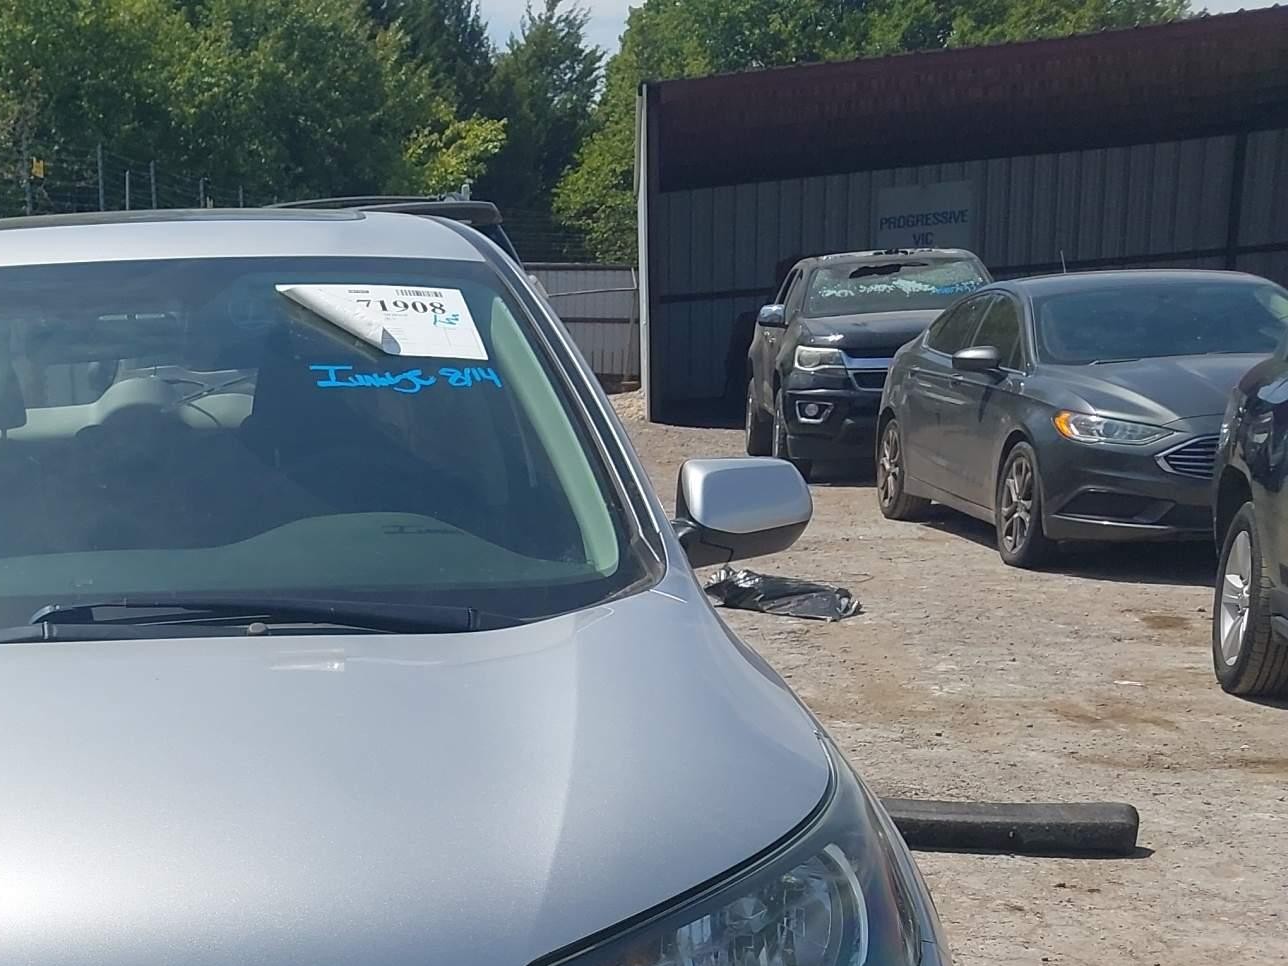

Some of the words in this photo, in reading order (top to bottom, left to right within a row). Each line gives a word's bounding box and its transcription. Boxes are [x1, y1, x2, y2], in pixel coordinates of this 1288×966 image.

[879, 209, 969, 231] PROGRESSIVE
[356, 299, 447, 315] 71908
[438, 367, 503, 388] 8/14
